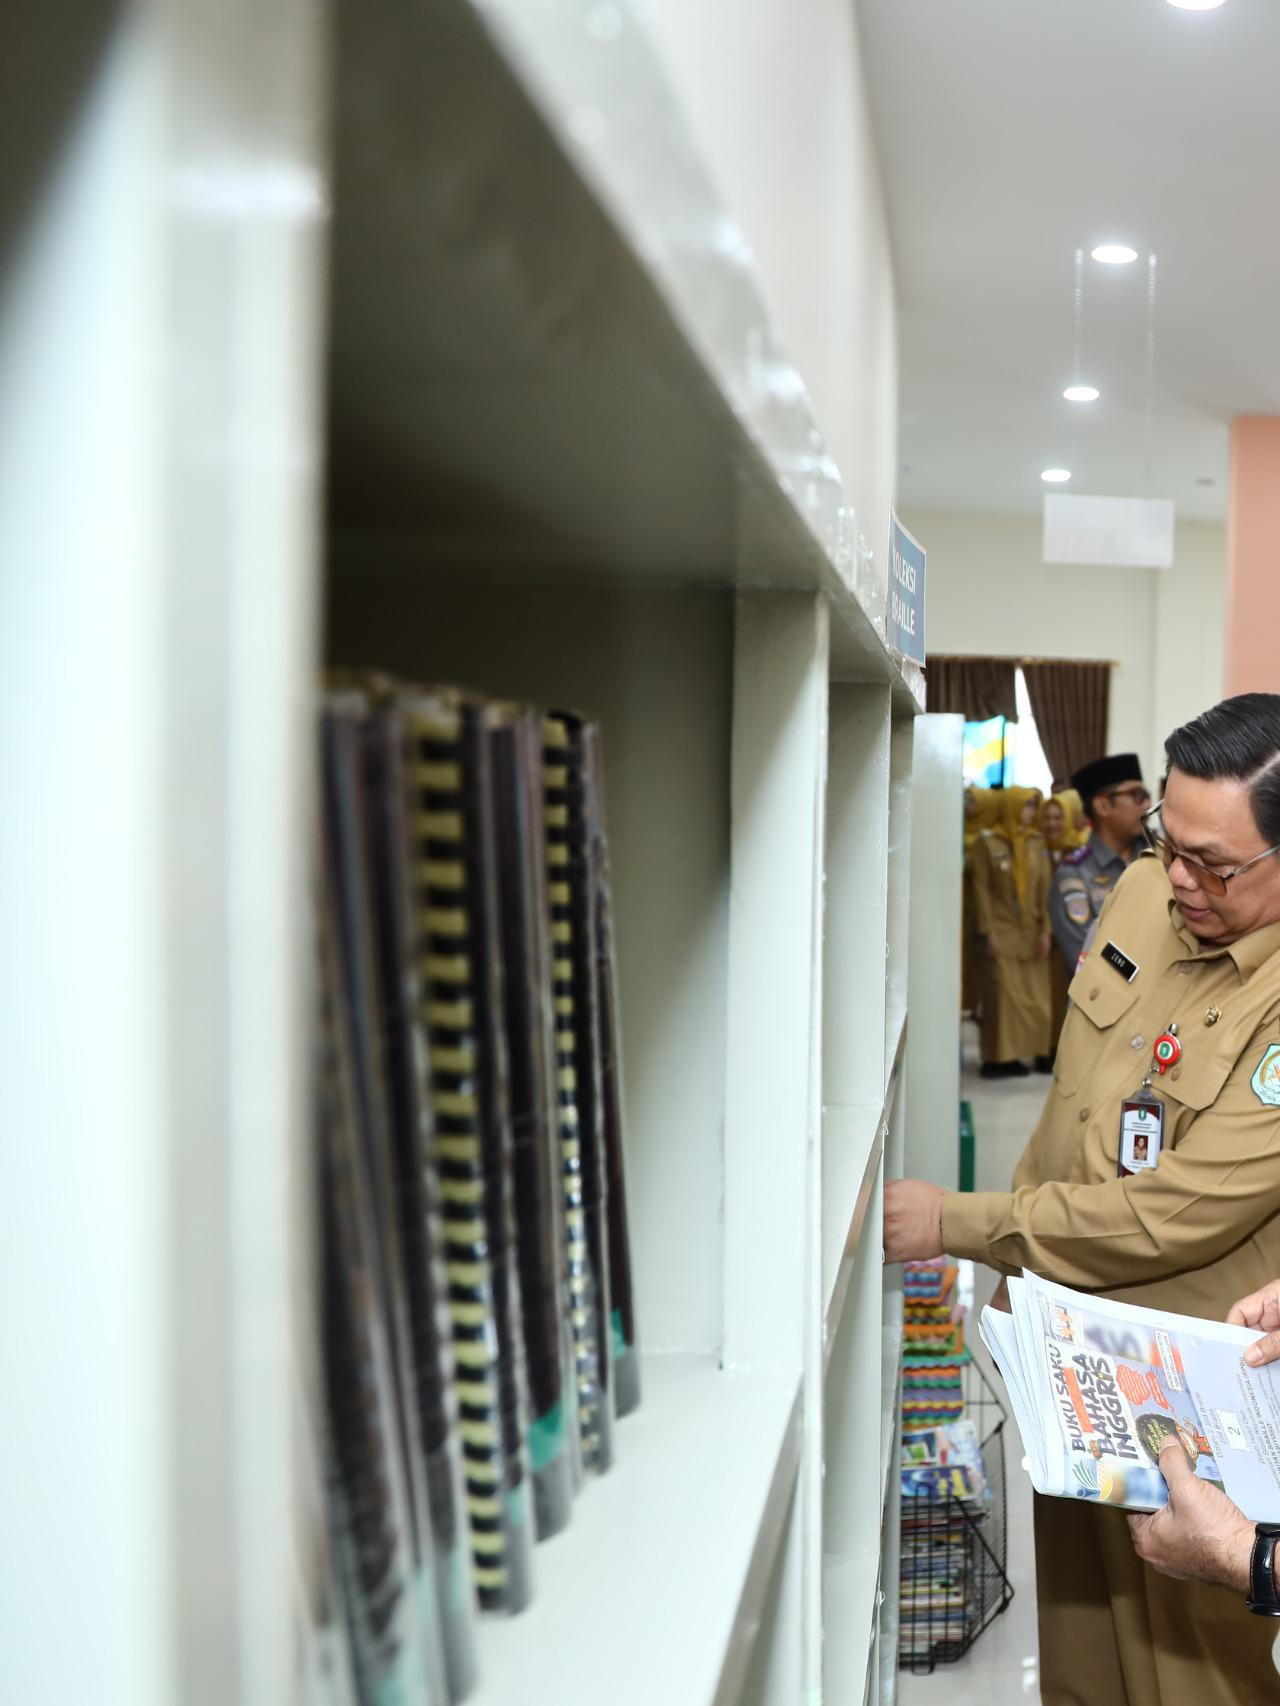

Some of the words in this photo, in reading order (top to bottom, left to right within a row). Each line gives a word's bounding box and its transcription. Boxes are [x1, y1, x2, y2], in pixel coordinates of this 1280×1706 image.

[891, 591, 915, 636] BRAILLE
[1048, 1343, 1069, 1396] SAKU
[1072, 1353, 1118, 1457] BAHASA
[1089, 1355, 1139, 1460] INGGRIS
[1245, 1380, 1262, 1419] INDONESIA
[1060, 1399, 1086, 1452] BUKU
[1227, 1426, 1241, 1436] 2
[1258, 1419, 1275, 1450] BRAILLE
